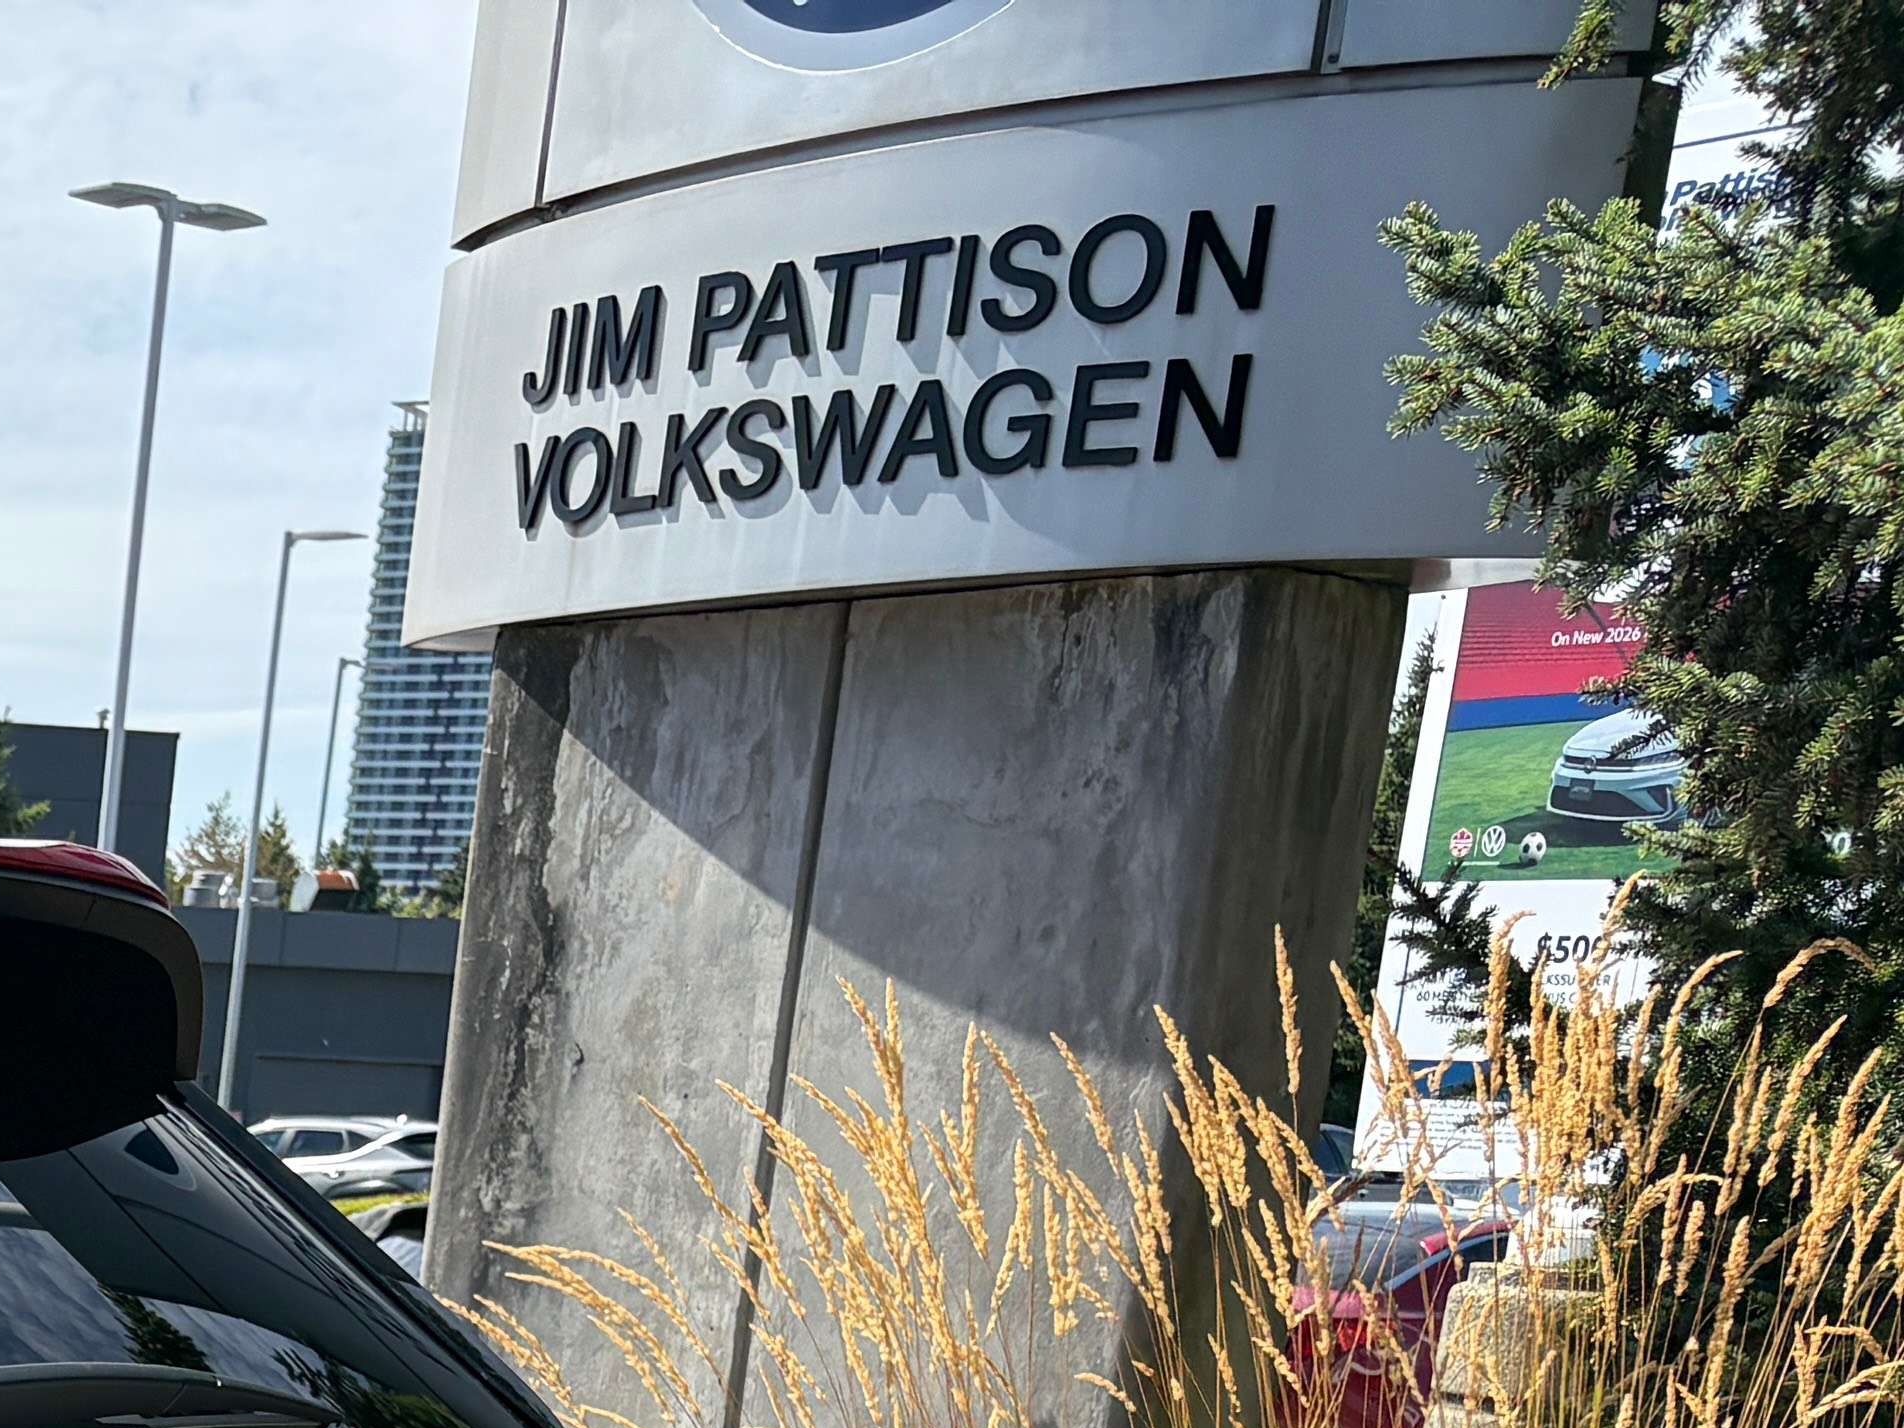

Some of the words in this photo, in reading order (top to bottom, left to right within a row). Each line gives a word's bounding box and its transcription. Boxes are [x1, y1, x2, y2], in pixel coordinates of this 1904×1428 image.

[1669, 168, 1782, 206] Pattis
[523, 284, 662, 403] JIM
[688, 204, 1275, 372] PATTISON
[515, 353, 1253, 532] VOLKSWAGEN
[1551, 631, 1570, 646] On
[1572, 630, 1604, 645] New
[1605, 626, 1641, 643] 2026
